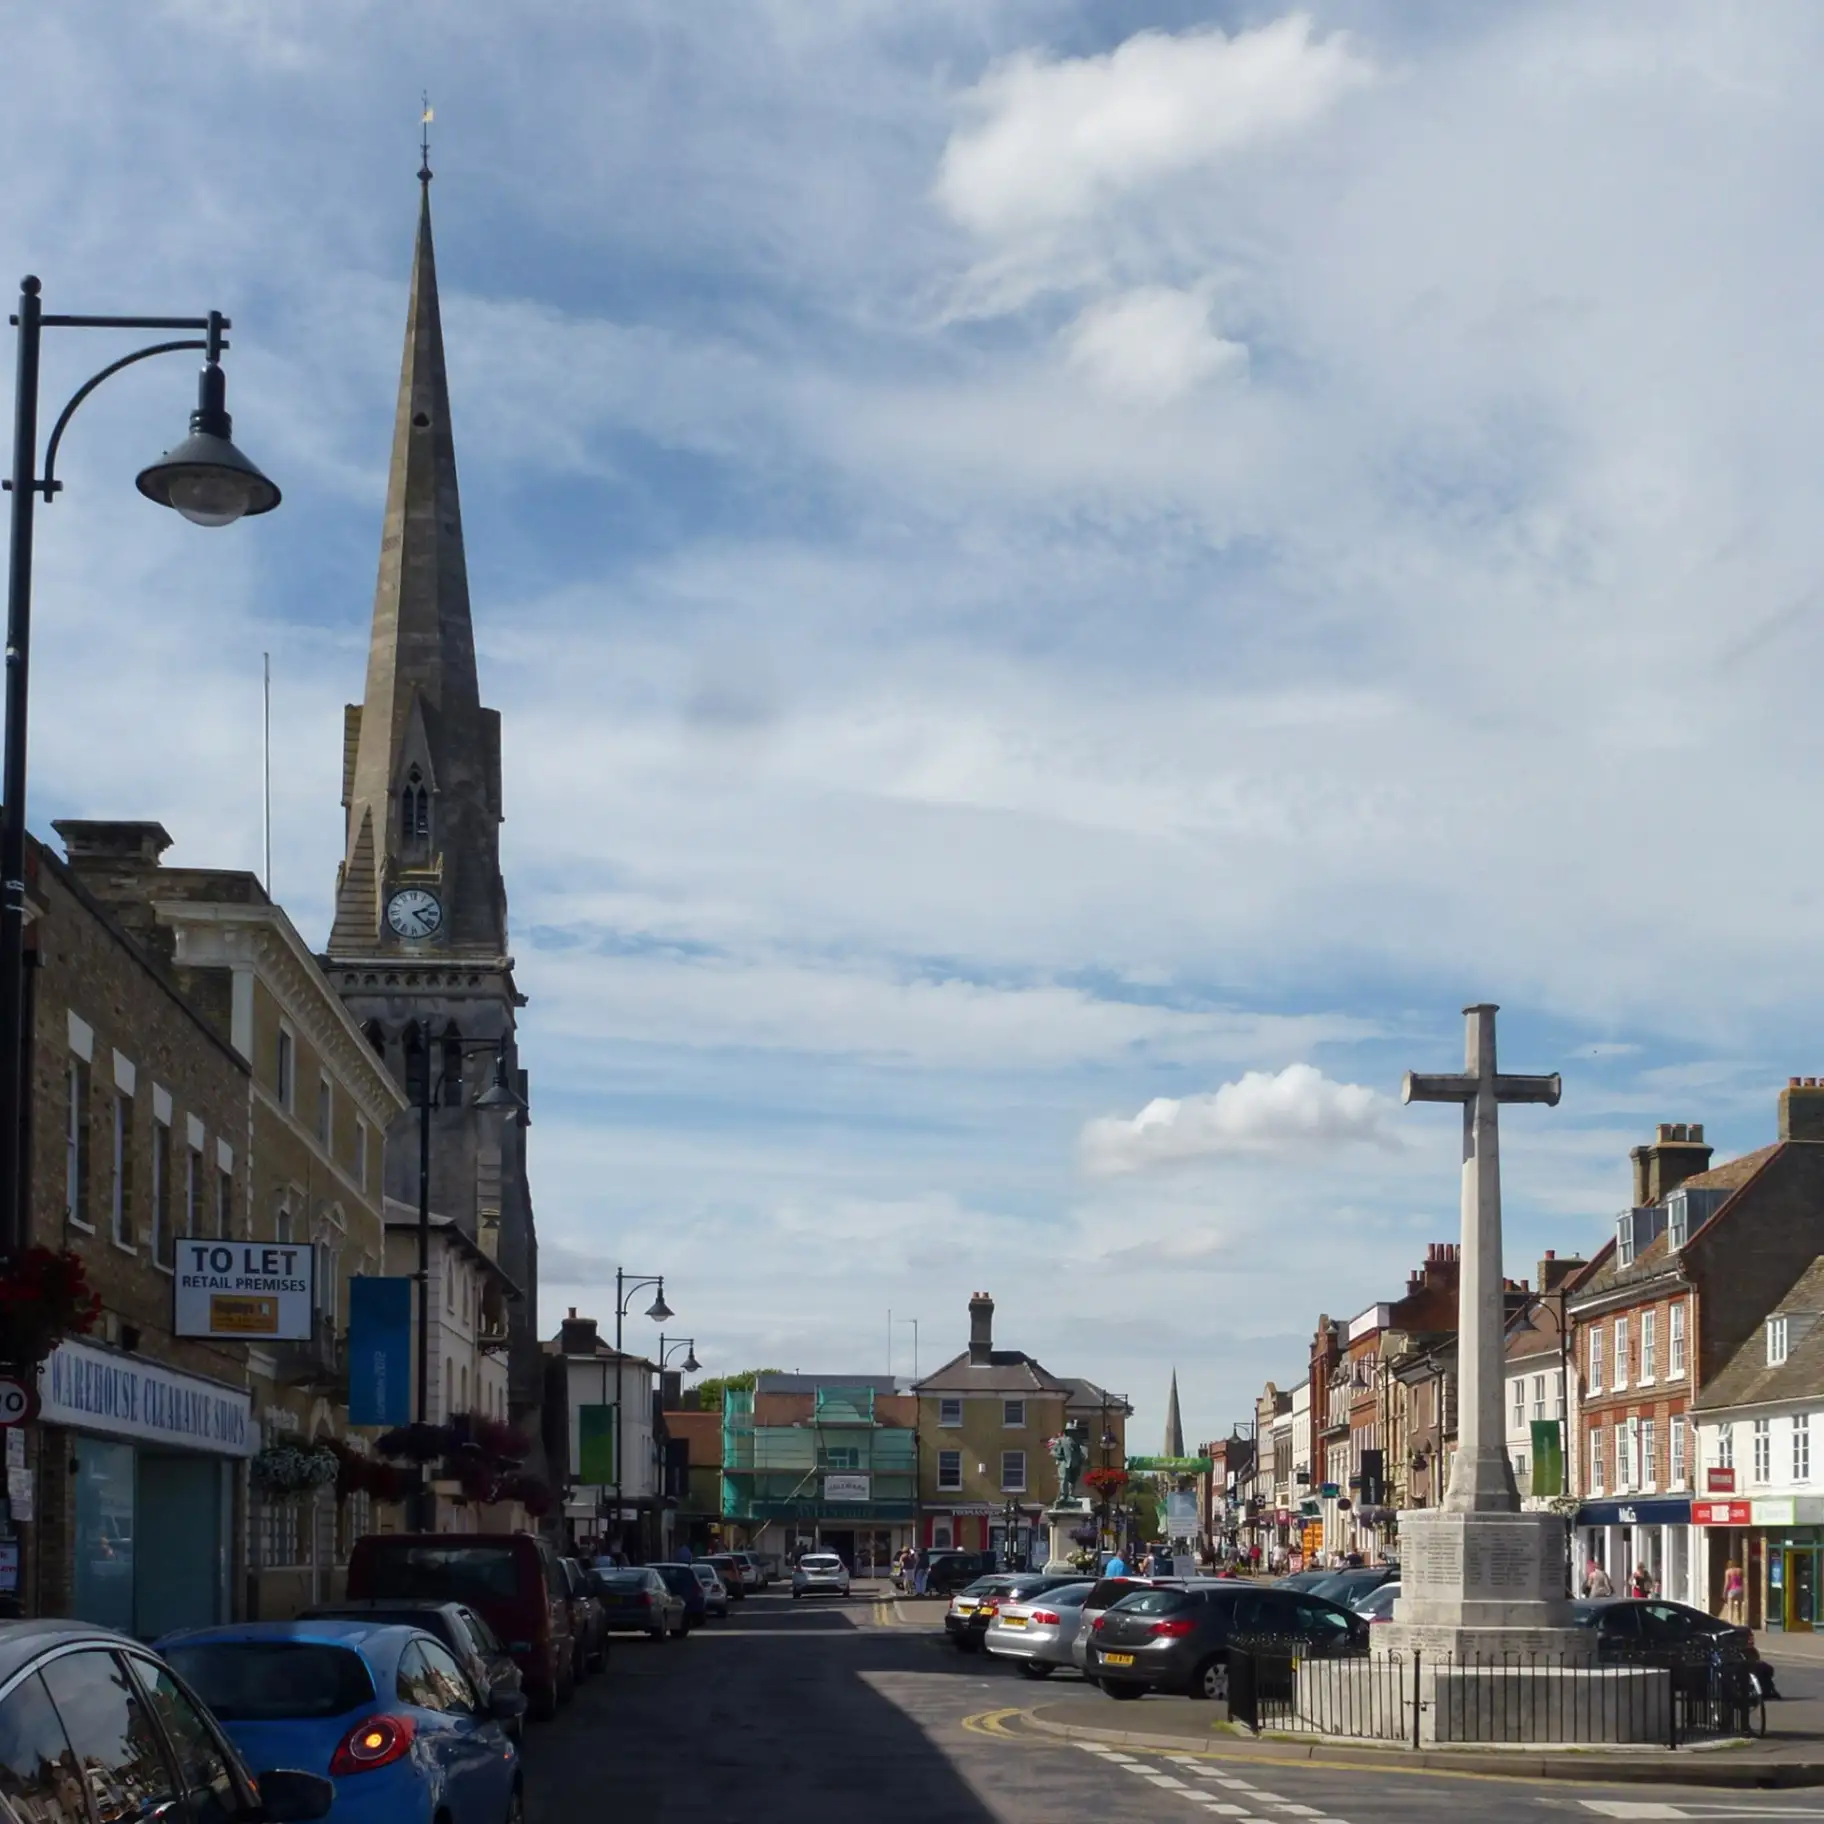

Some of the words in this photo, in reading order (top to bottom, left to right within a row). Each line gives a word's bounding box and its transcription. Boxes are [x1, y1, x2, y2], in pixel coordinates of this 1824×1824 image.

[191, 1246, 233, 1273] TO
[244, 1249, 298, 1276] LET
[182, 1275, 232, 1289] RETAIL
[235, 1277, 307, 1292] PREMISES
[0, 1392, 24, 1412] 0
[51, 1351, 139, 1422] WAREHOUSE
[143, 1378, 211, 1437] CLEARANCE
[214, 1398, 245, 1445] SHOPS
